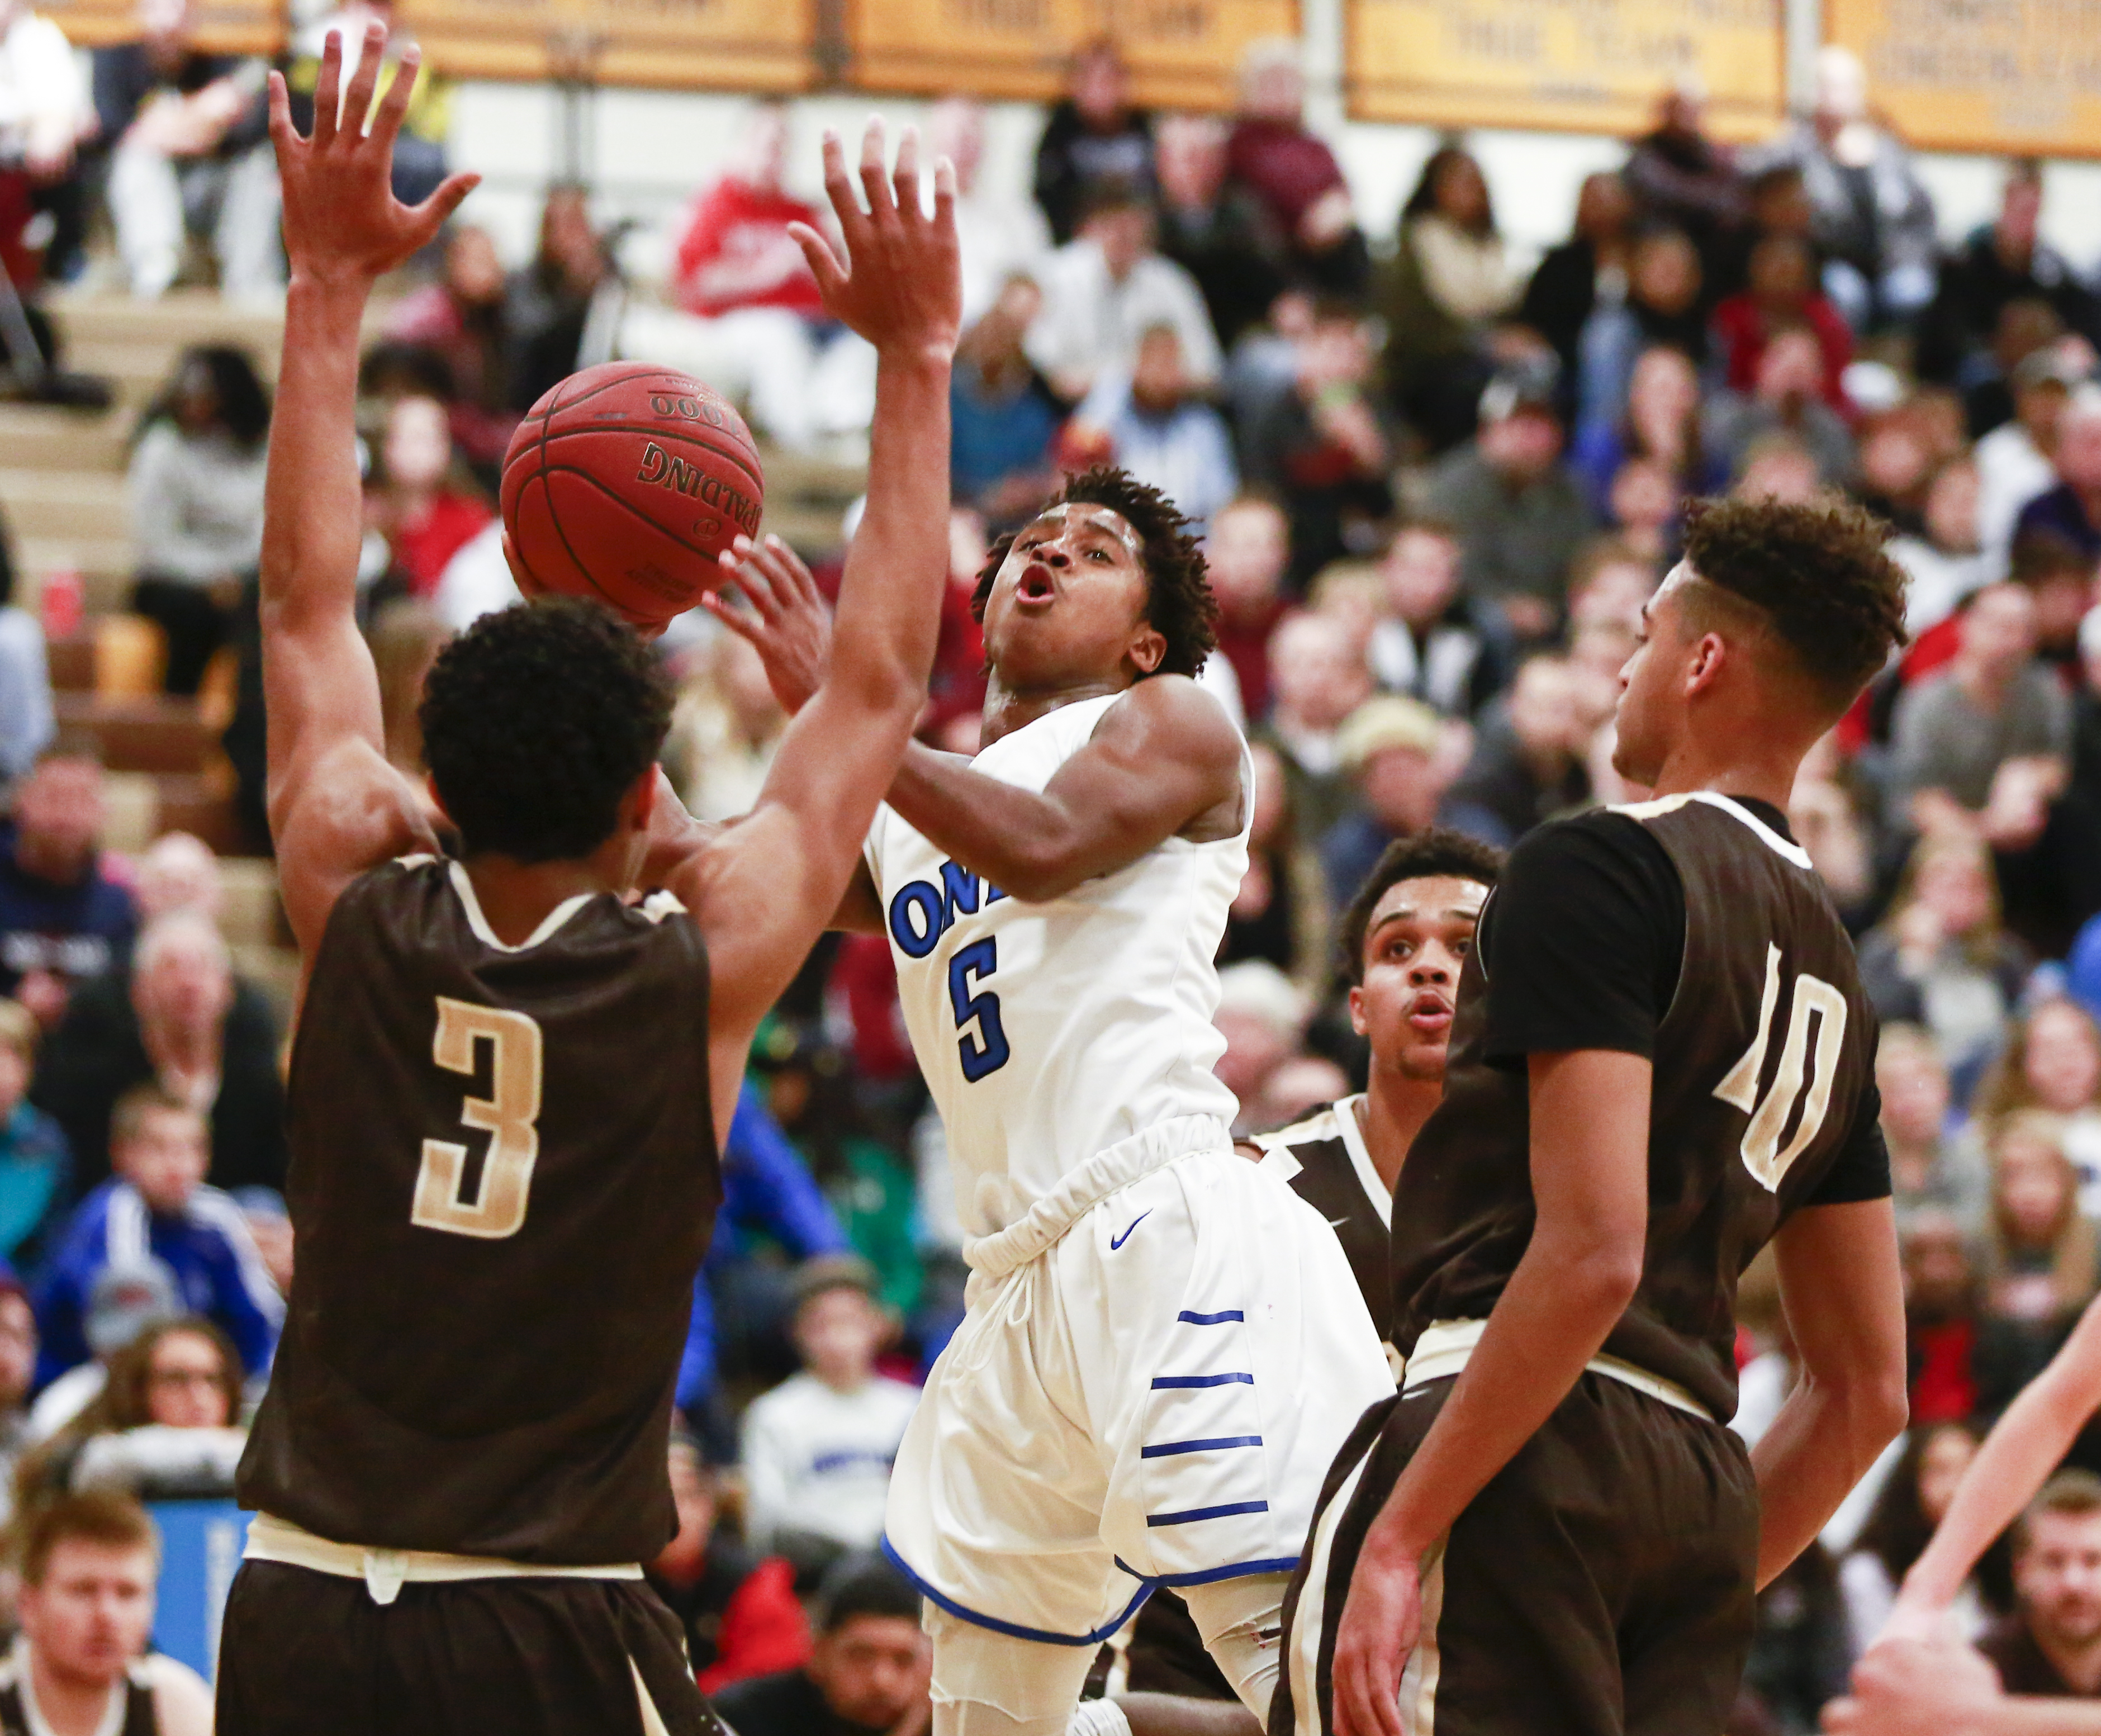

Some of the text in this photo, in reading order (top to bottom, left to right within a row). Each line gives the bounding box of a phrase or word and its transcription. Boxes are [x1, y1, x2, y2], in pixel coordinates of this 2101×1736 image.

[889, 858, 1006, 959] ON
[948, 935, 1010, 1083] 5
[1711, 940, 1848, 1194] 10
[410, 995, 543, 1239] 3
